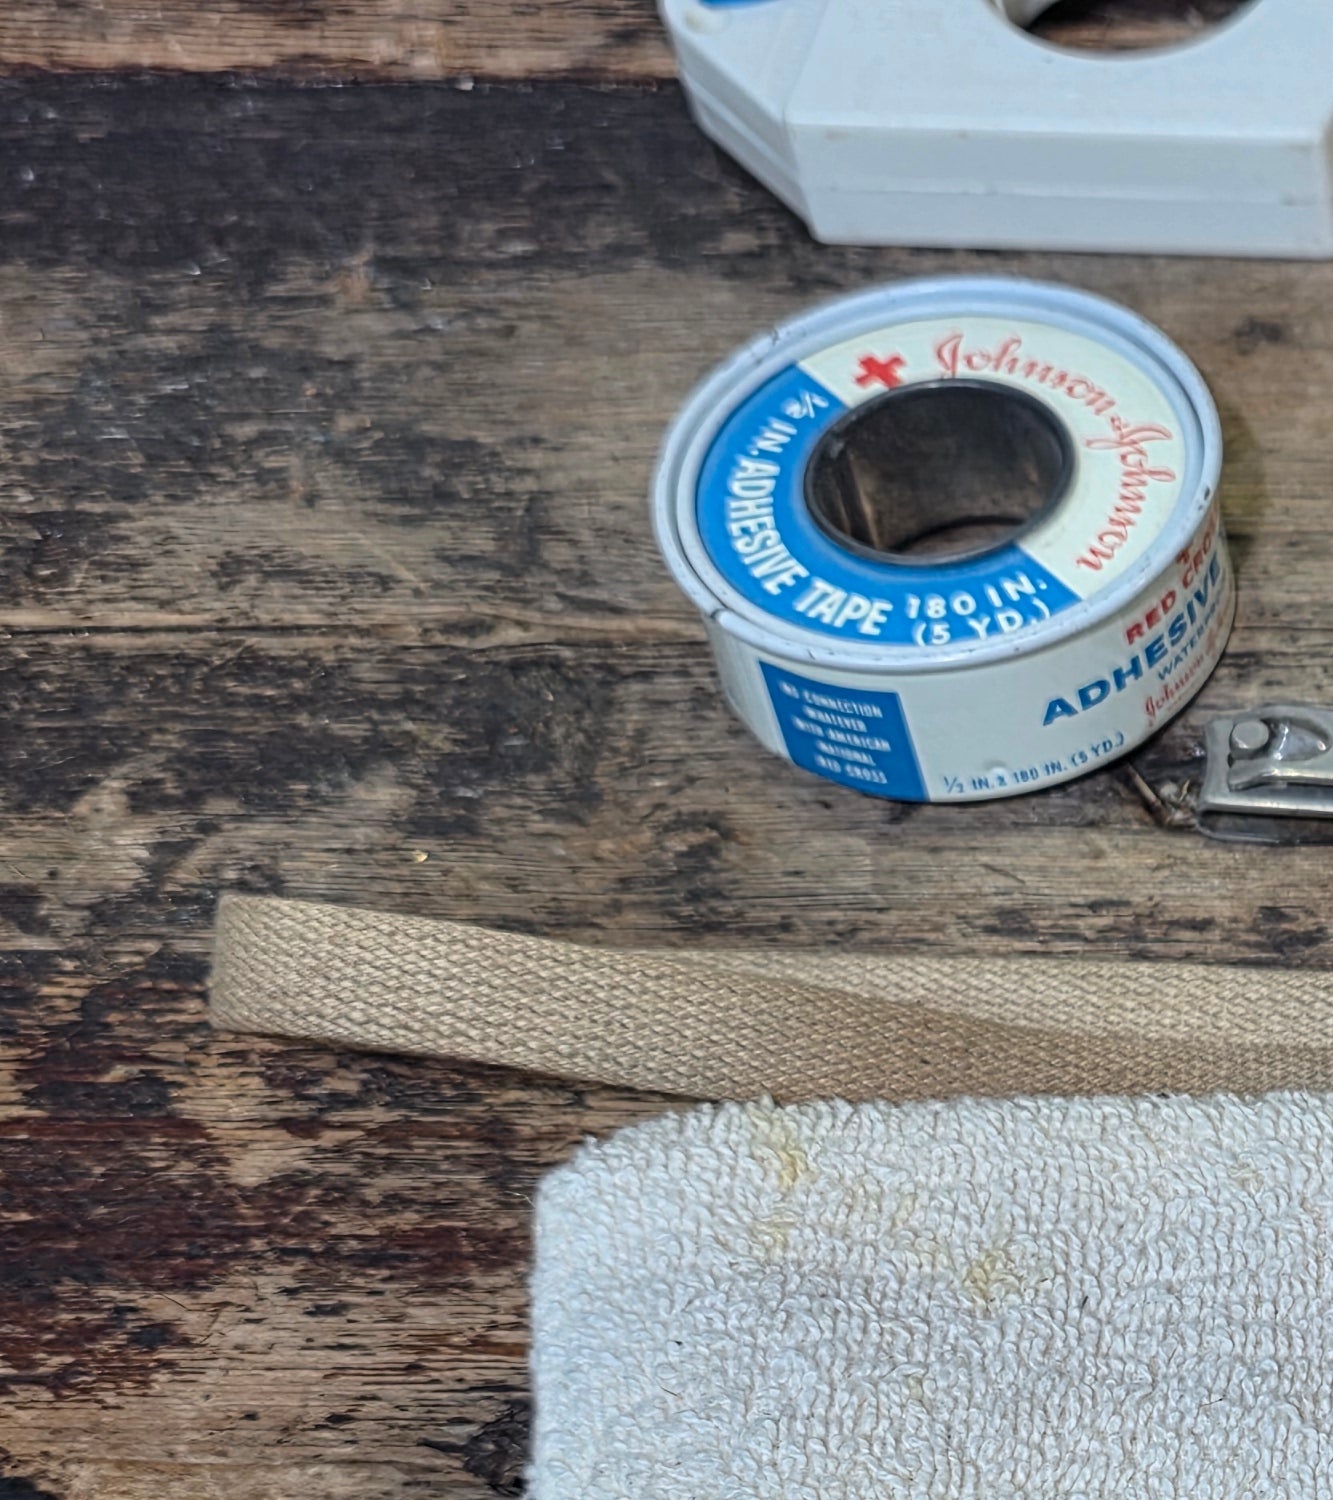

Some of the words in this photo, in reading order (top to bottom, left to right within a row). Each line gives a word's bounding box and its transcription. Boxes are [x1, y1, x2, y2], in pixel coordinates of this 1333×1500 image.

[748, 417, 797, 455] IN.
[935, 332, 1115, 415] Johnson
[1077, 424, 1176, 571] Johnson
[728, 454, 810, 595] ADHESIVE
[793, 577, 893, 635] TAPE
[905, 591, 976, 619] 180
[984, 571, 1047, 608] IN.
[1125, 589, 1176, 645] RED
[913, 622, 950, 646] (5
[1043, 552, 1220, 726] ADHESIVE
